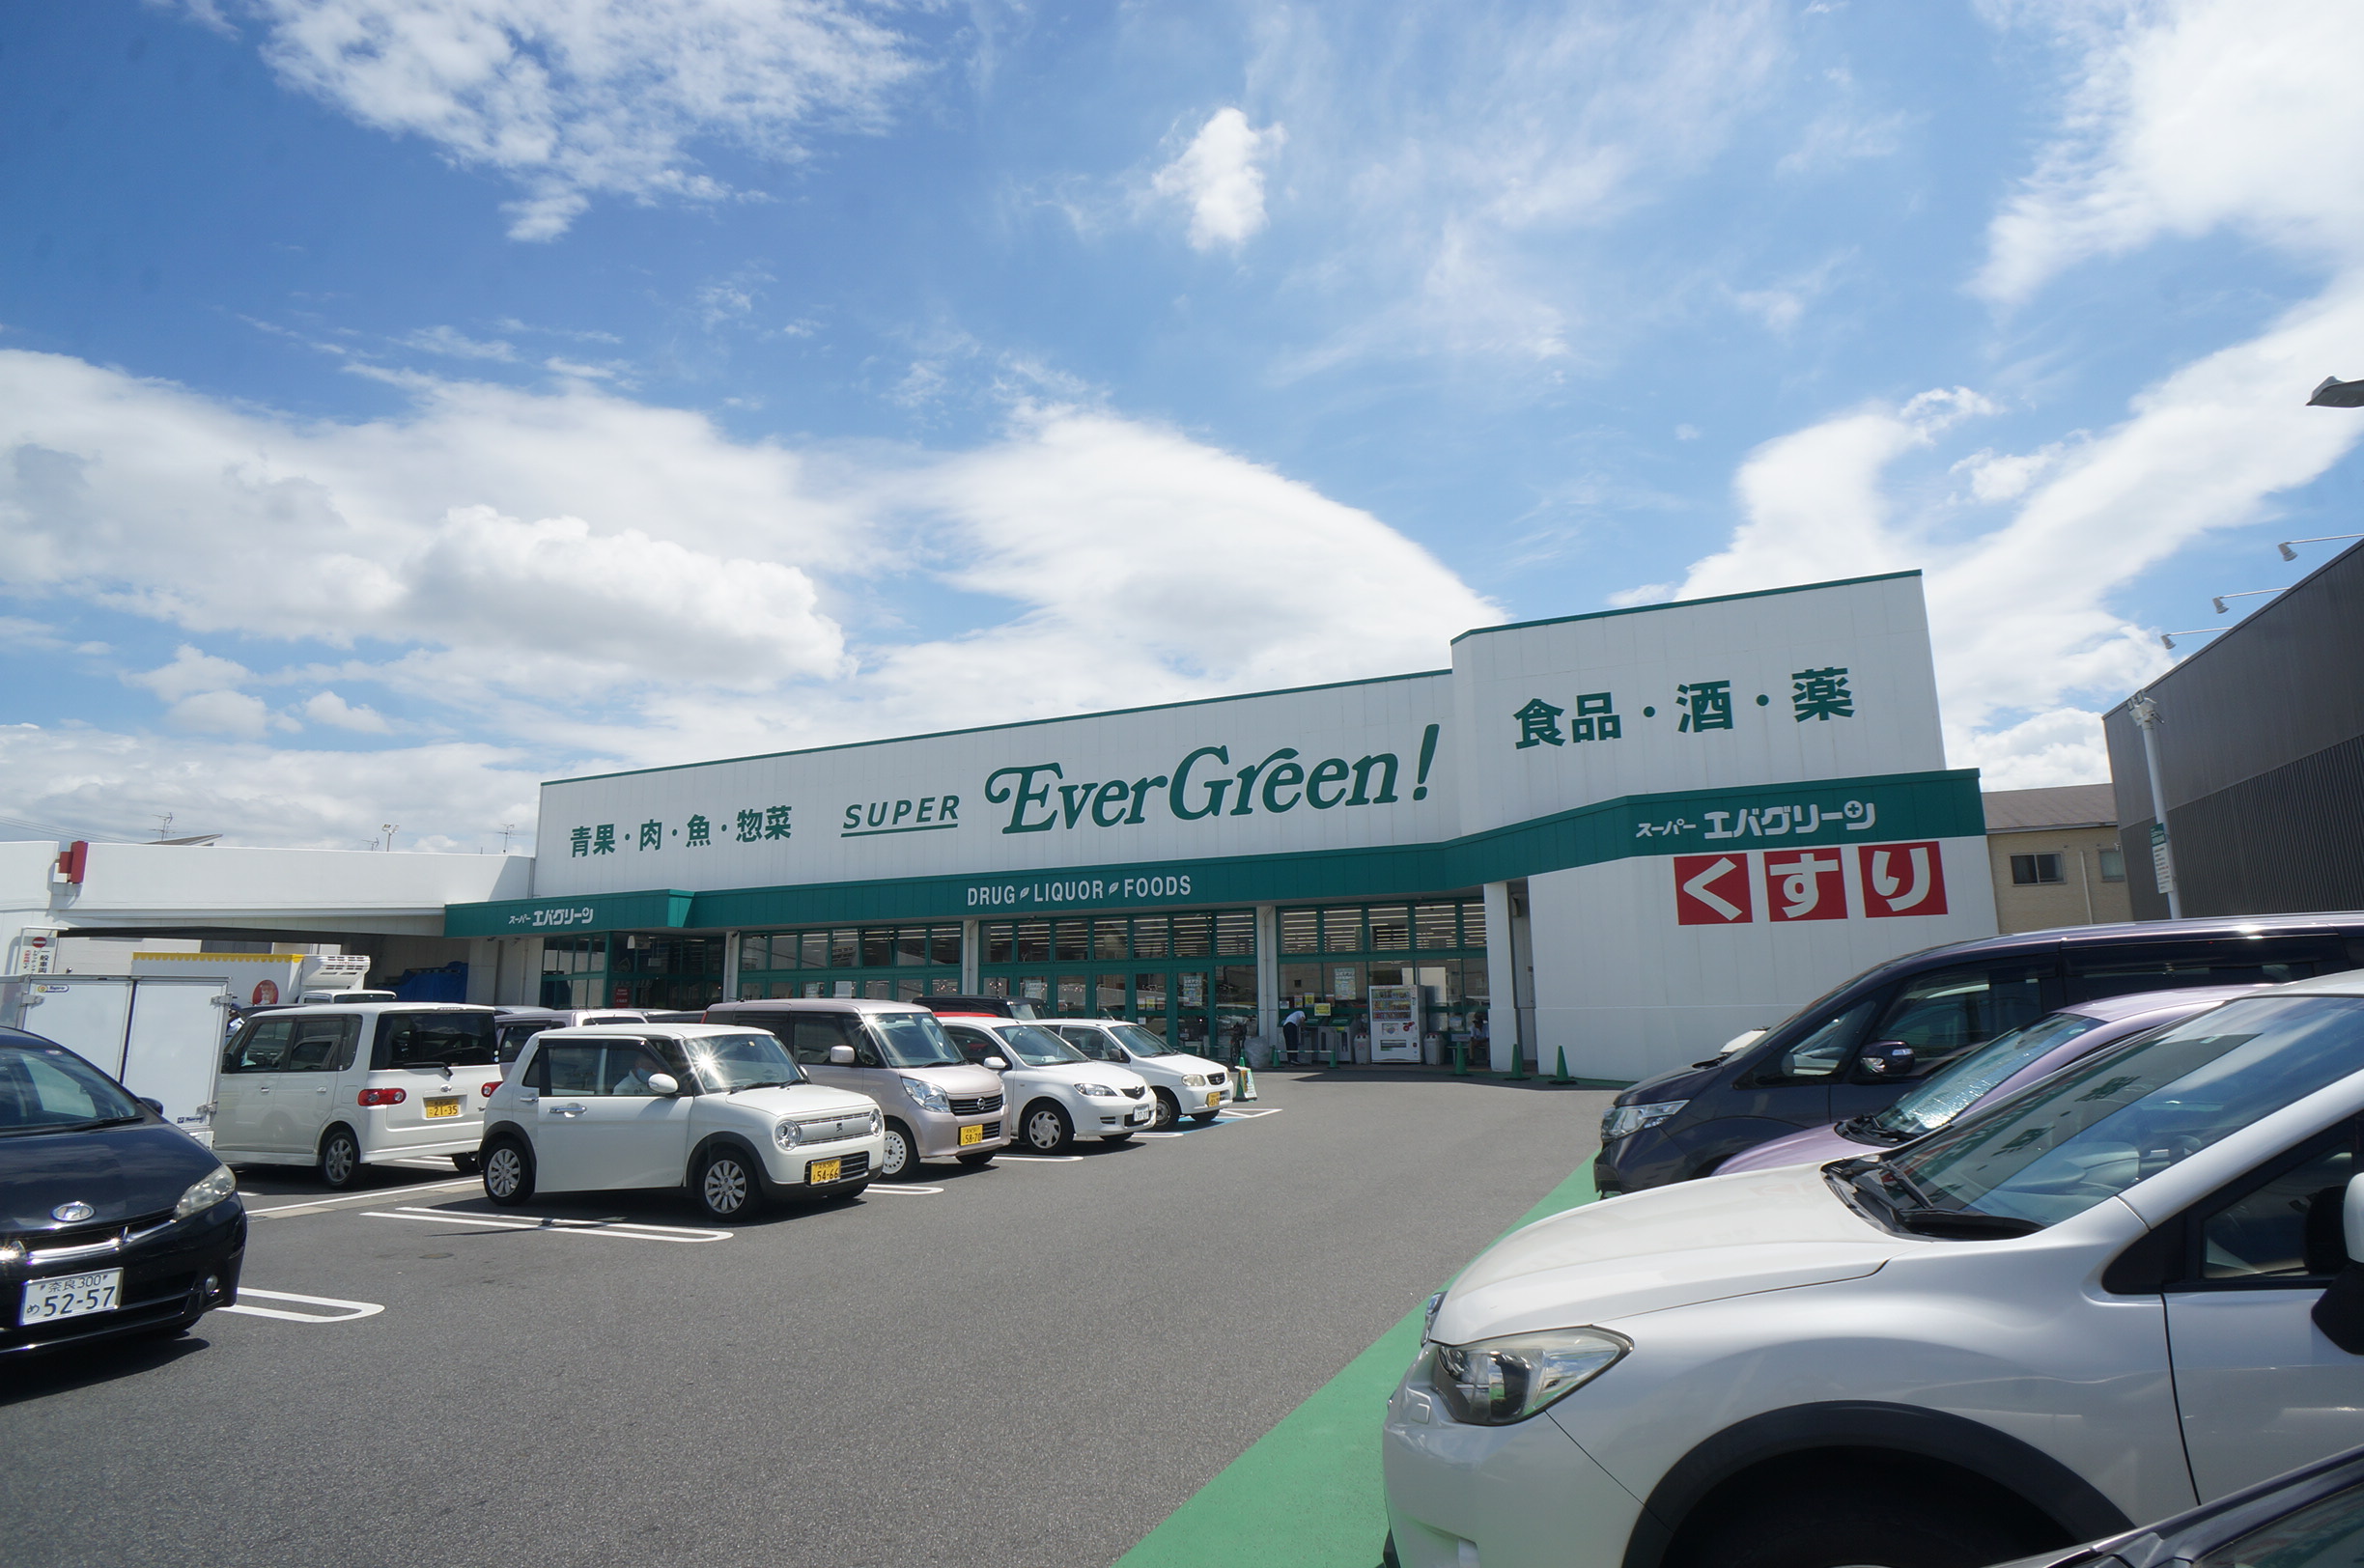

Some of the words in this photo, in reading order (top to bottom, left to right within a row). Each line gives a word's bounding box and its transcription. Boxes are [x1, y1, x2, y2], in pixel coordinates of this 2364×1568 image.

[1513, 666, 1856, 750] 食品・酒・薬
[843, 795, 960, 829] SUPER
[984, 723, 1440, 835] EverGreen!
[570, 804, 793, 858] 青果・肉・魚・惣菜
[1635, 818, 1697, 838] スーパー
[1703, 799, 1876, 840] エバグリーン
[967, 885, 1016, 907] DRUG
[1033, 880, 1104, 903] LIQUOR
[1123, 875, 1192, 898] FOODS
[1682, 846, 1932, 923] くすり
[508, 913, 531, 925] スーパー
[532, 907, 594, 927] エバグリーン
[26, 1304, 40, 1315] め
[43, 1285, 116, 1317] 52-57
